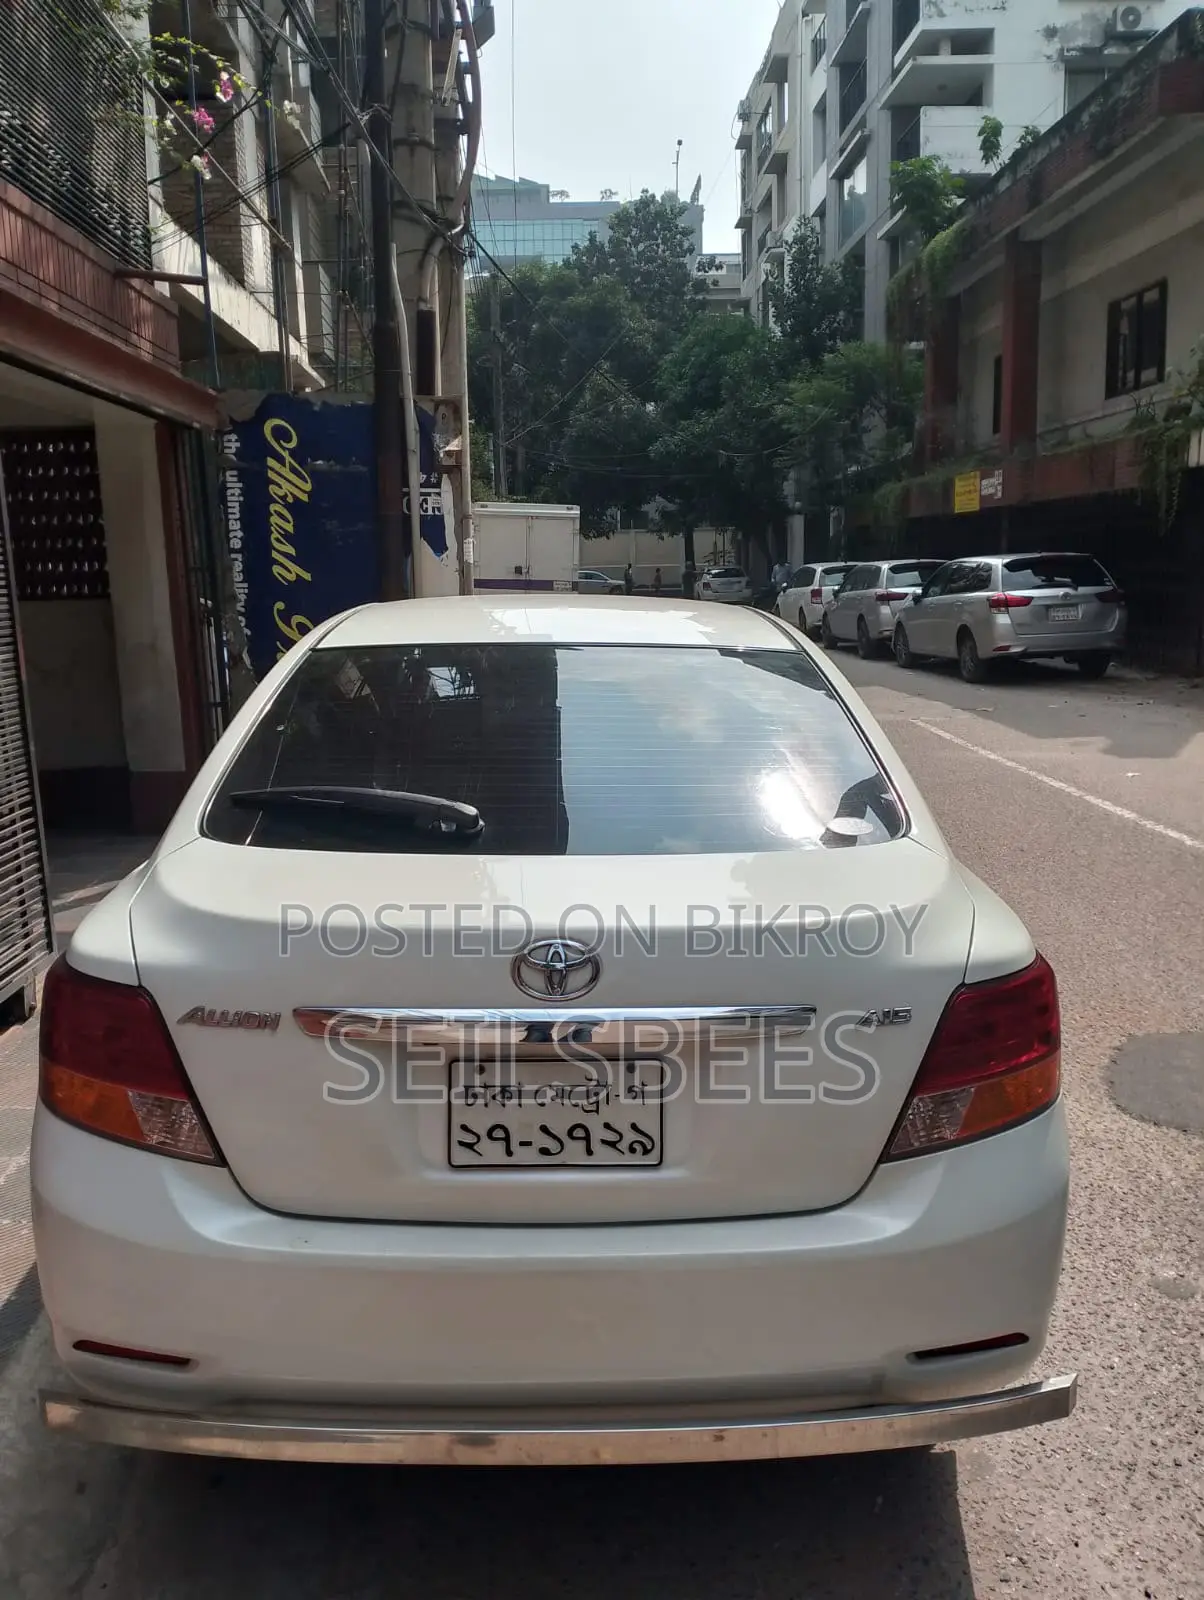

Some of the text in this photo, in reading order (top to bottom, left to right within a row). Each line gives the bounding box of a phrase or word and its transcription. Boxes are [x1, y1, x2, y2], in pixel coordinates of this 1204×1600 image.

[226, 469, 244, 549] ultimate
[264, 418, 313, 586] Akash
[176, 1006, 281, 1031] ALLION
[464, 1082, 523, 1108] ঢাকা
[457, 1122, 655, 1157] ২৭-১৭২৯
